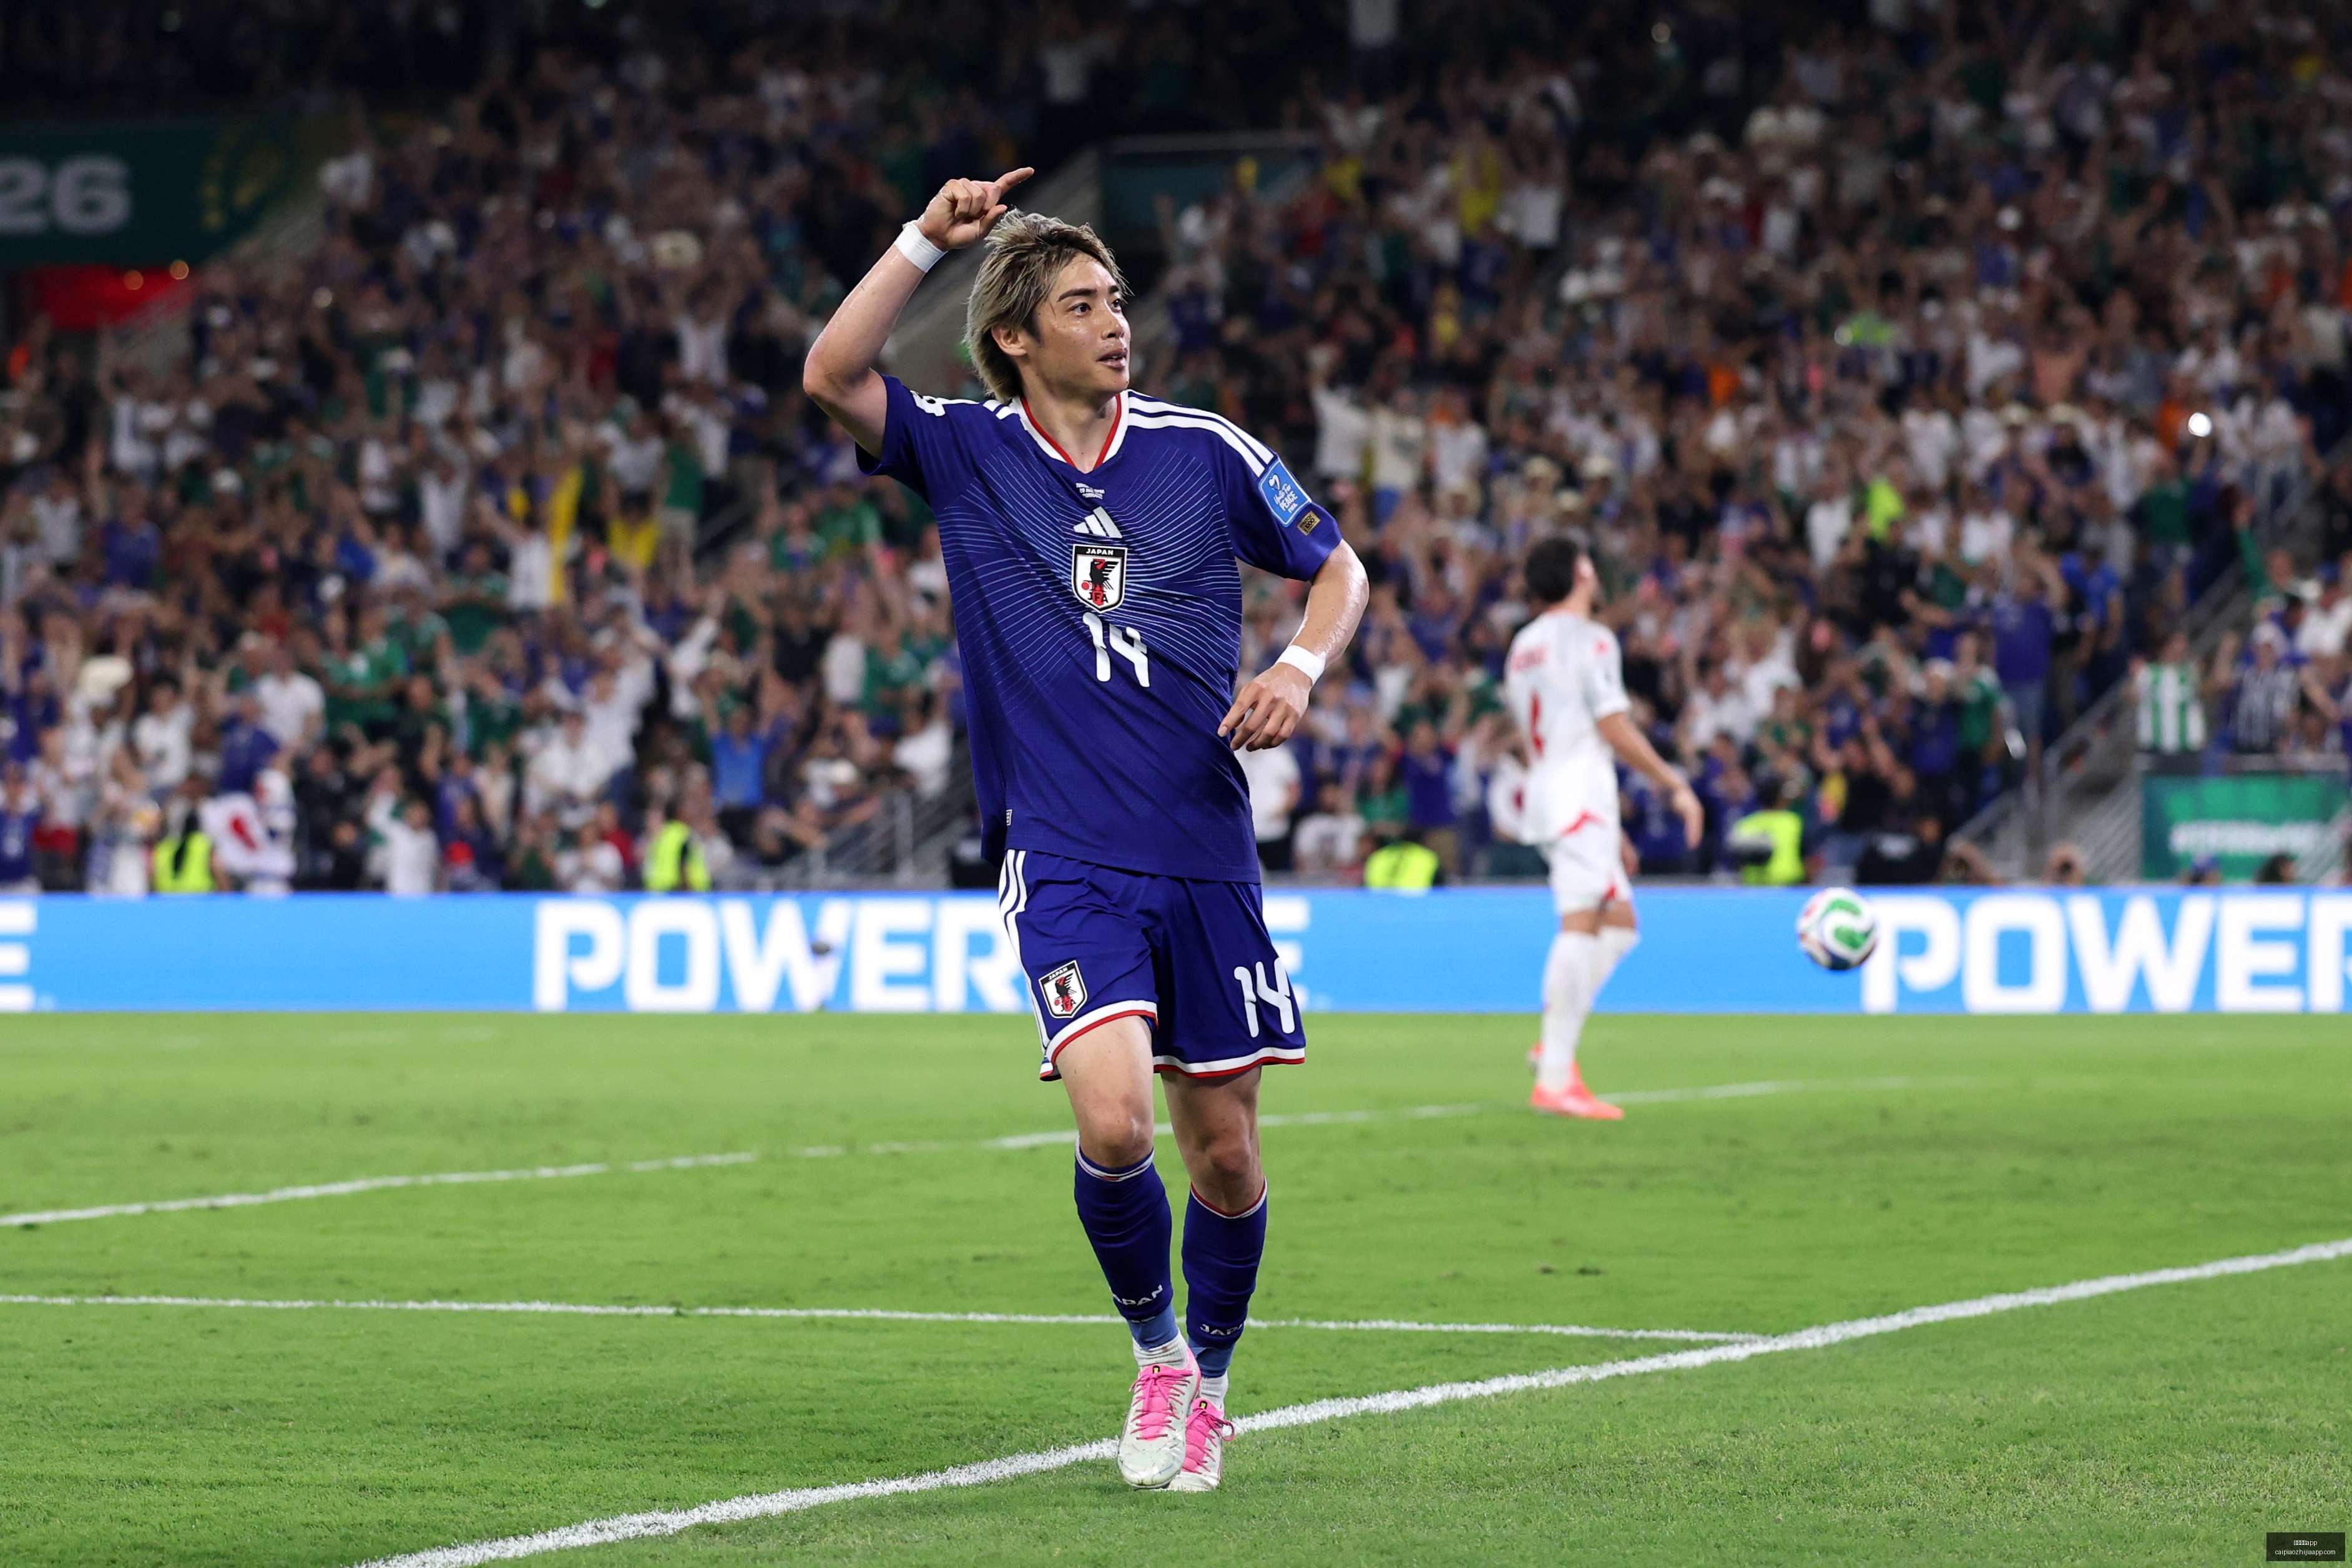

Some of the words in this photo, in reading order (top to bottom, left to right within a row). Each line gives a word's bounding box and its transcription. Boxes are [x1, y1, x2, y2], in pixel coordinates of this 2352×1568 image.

[1279, 491, 1298, 511] PEACE
[1087, 590, 1109, 604] JFA
[1082, 612, 1150, 687] 14
[1049, 967, 1068, 980] JAPAN
[1061, 999, 1077, 1012] JFA
[1233, 957, 1295, 1038] 14
